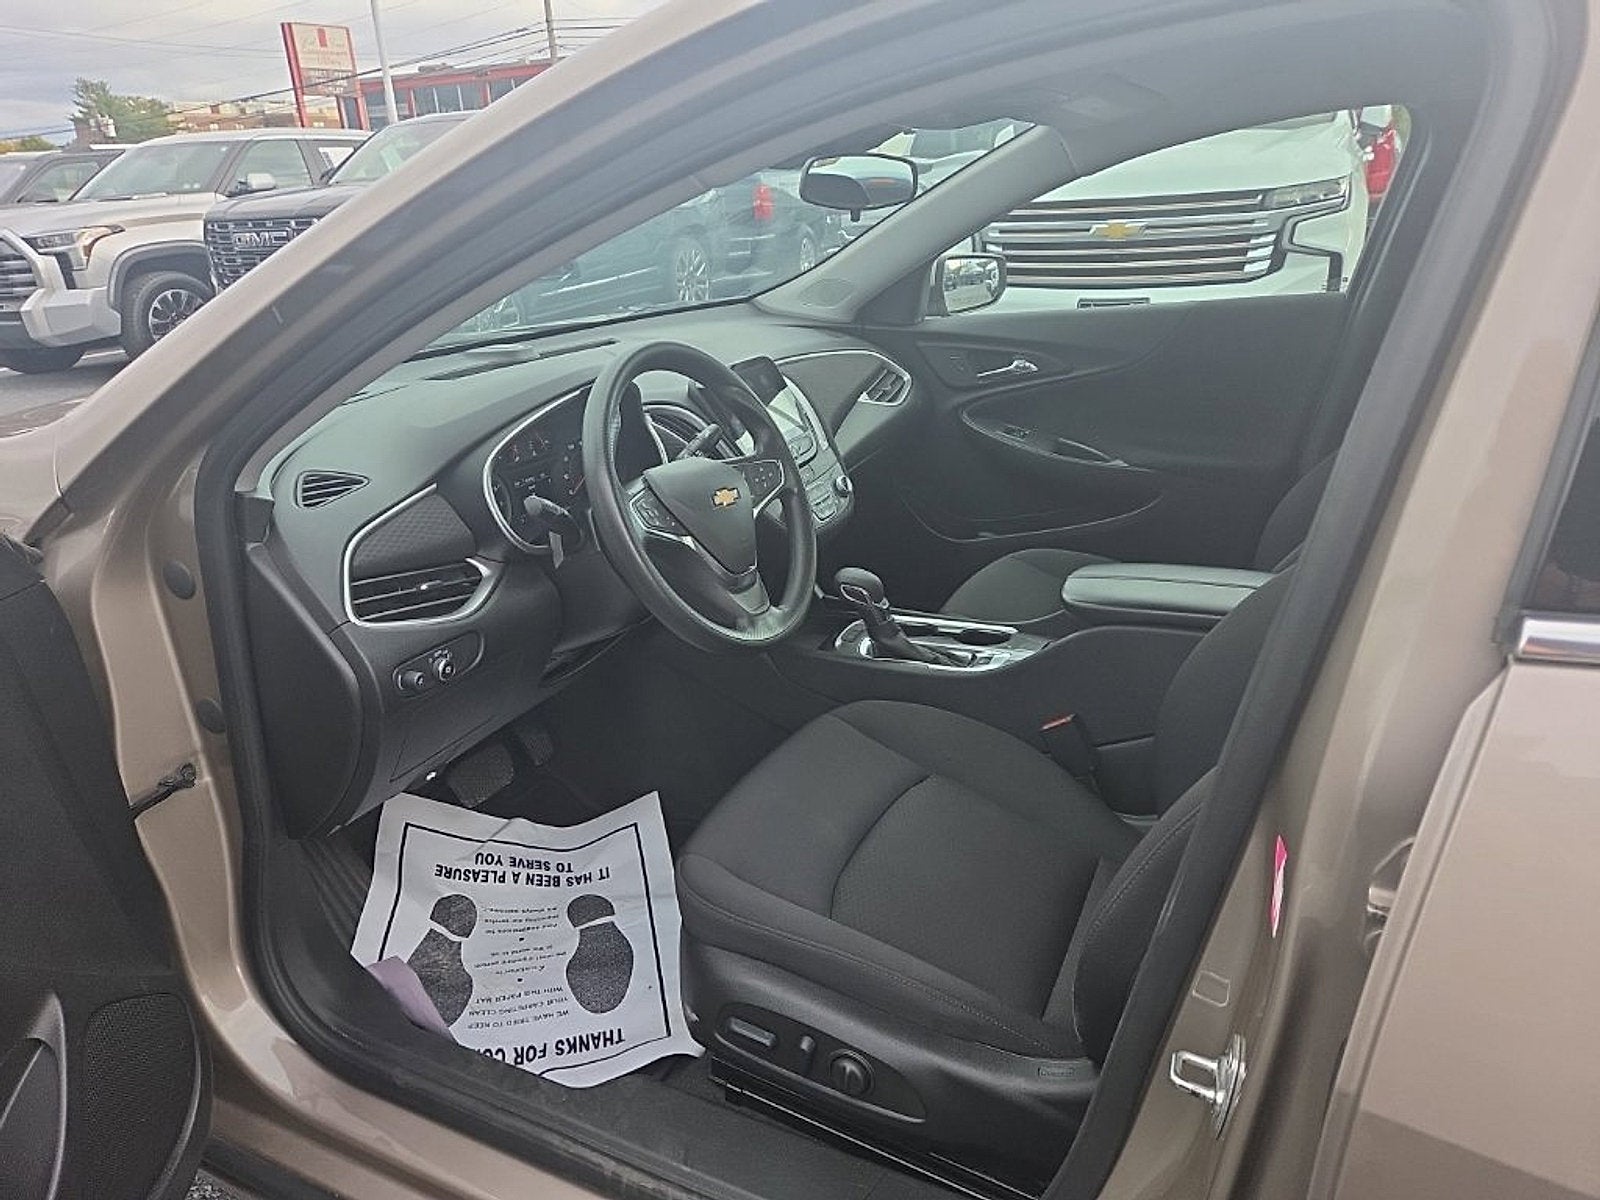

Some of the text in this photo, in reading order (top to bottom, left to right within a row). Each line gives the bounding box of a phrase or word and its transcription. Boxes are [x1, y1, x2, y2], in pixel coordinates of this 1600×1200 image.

[233, 231, 289, 246] GMC
[474, 852, 574, 873] TO SERVE YOU
[434, 863, 611, 887] IT HAS BEEN A PLEASURE
[544, 986, 563, 994] WITH
[495, 992, 522, 1000] PAPER
[468, 1009, 497, 1017] CLEAN
[534, 1012, 554, 1021] HAVE
[557, 1009, 569, 1017] WE
[507, 1017, 530, 1026] TRIED
[554, 1028, 626, 1056] THANKS
[513, 1042, 547, 1065] FOR
